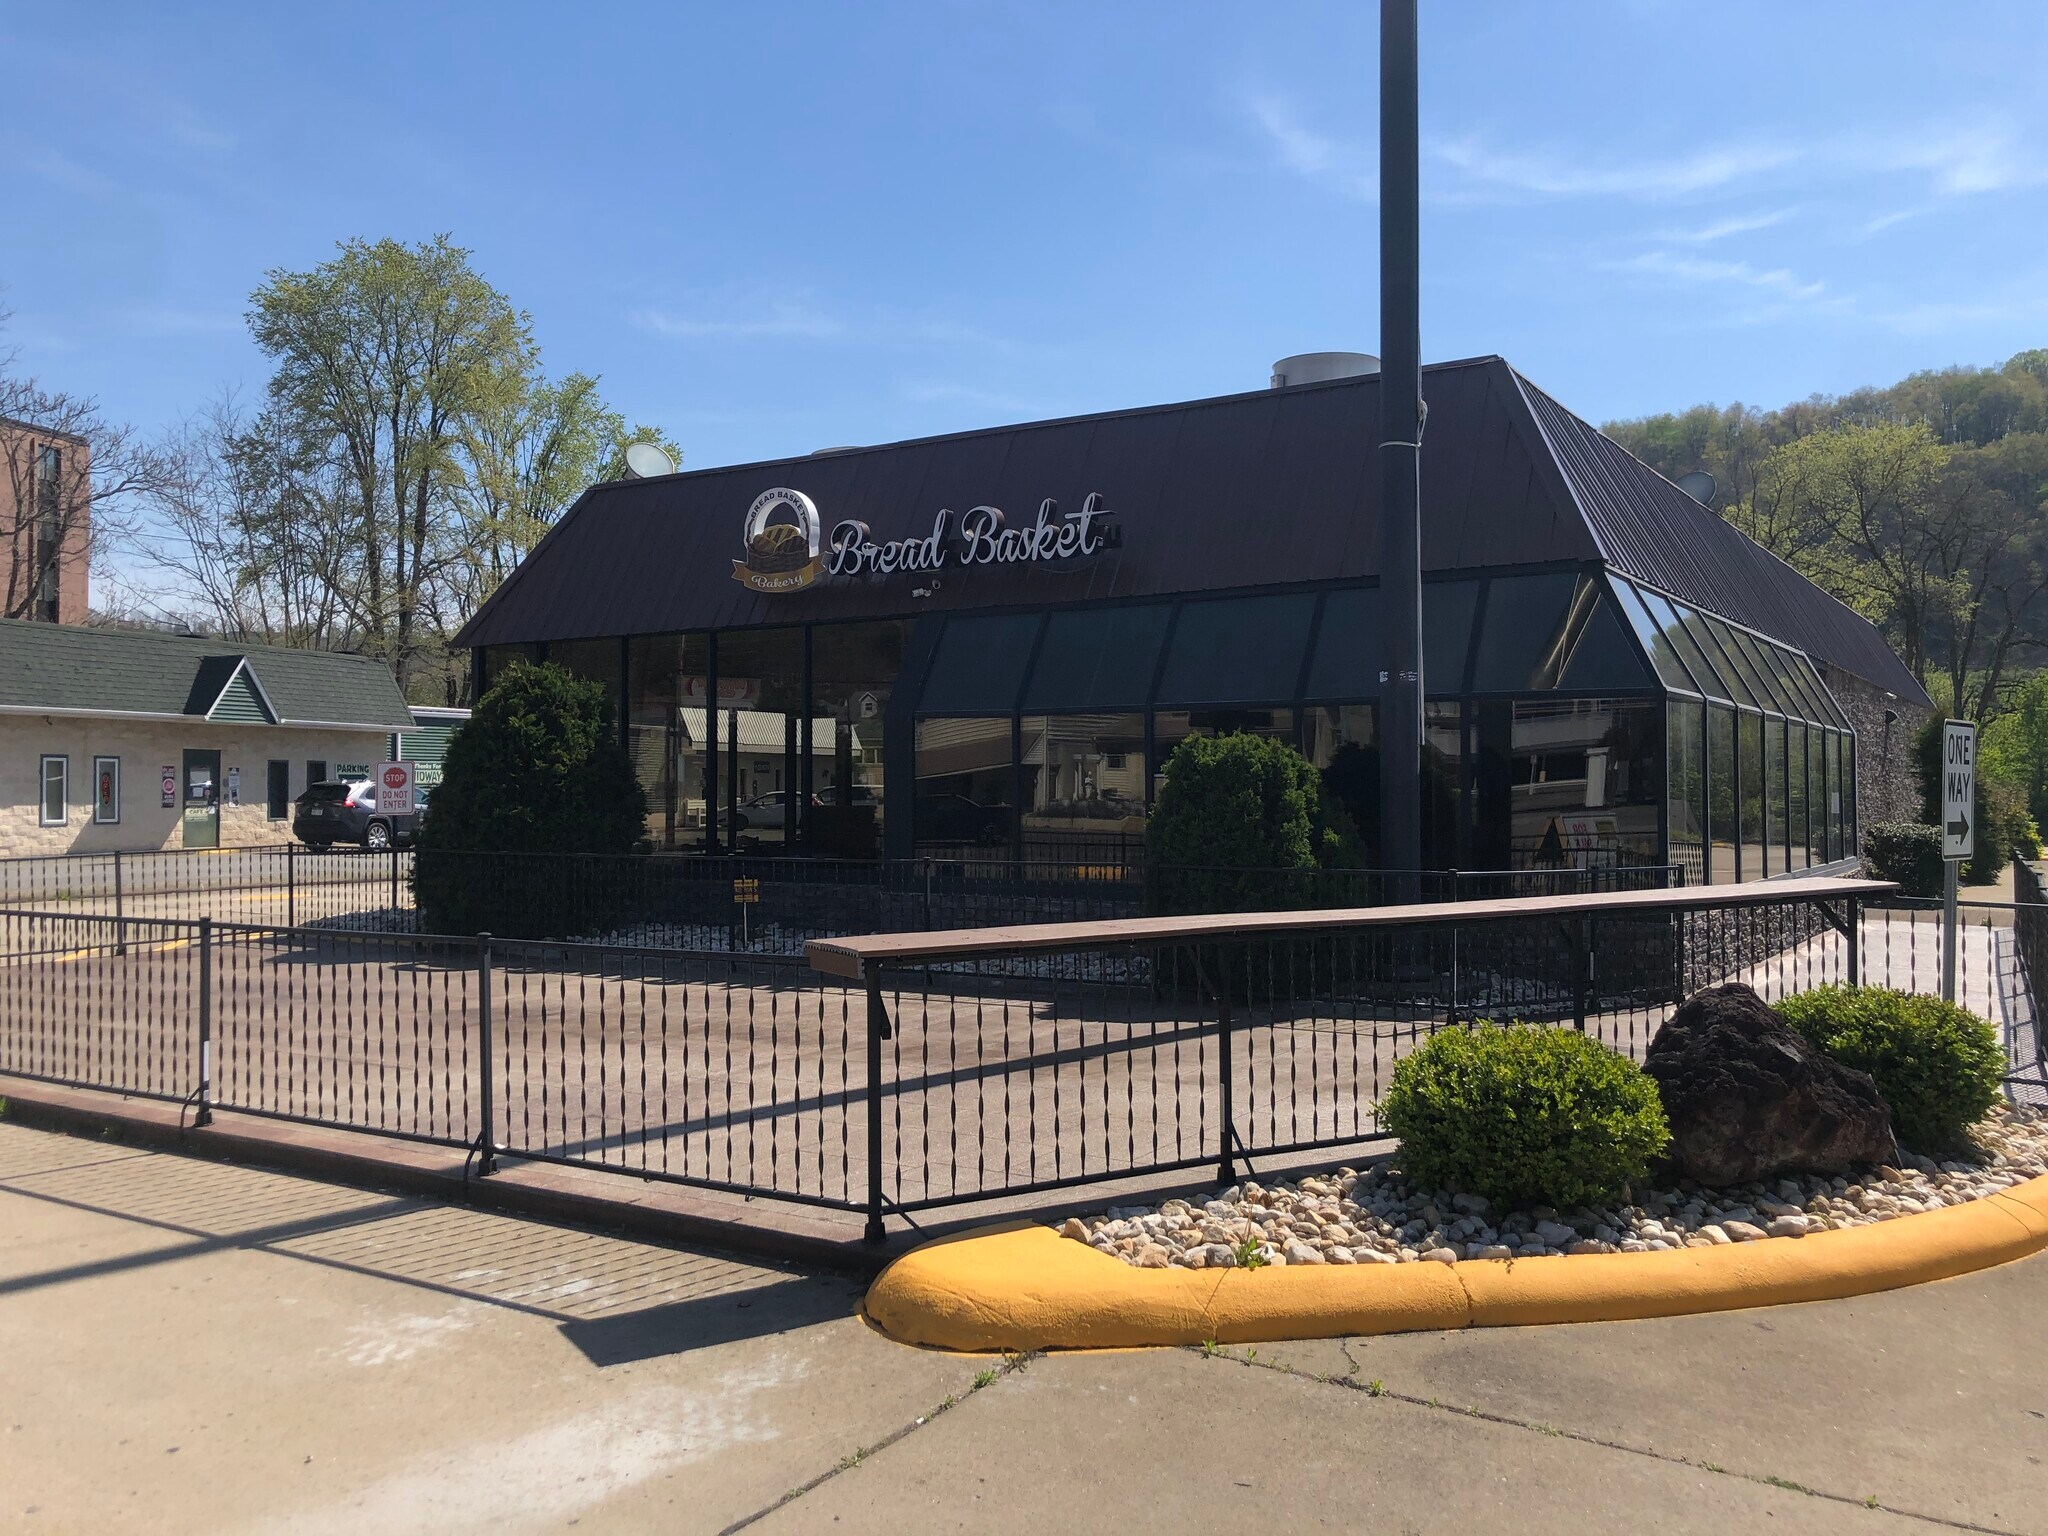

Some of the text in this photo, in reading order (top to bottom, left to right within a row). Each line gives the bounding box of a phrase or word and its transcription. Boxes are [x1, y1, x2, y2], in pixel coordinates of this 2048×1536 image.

[750, 491, 807, 518] BREAD BASKET
[828, 491, 1117, 576] Bread Basket
[751, 575, 804, 588] Bakery
[1948, 733, 1970, 766] ONE
[337, 764, 369, 773] PARKING
[385, 774, 405, 782] STOP
[414, 771, 441, 783] IDWAY
[1948, 771, 1970, 803] WAY
[382, 790, 408, 799] DO NOT
[383, 800, 407, 809] ENTER
